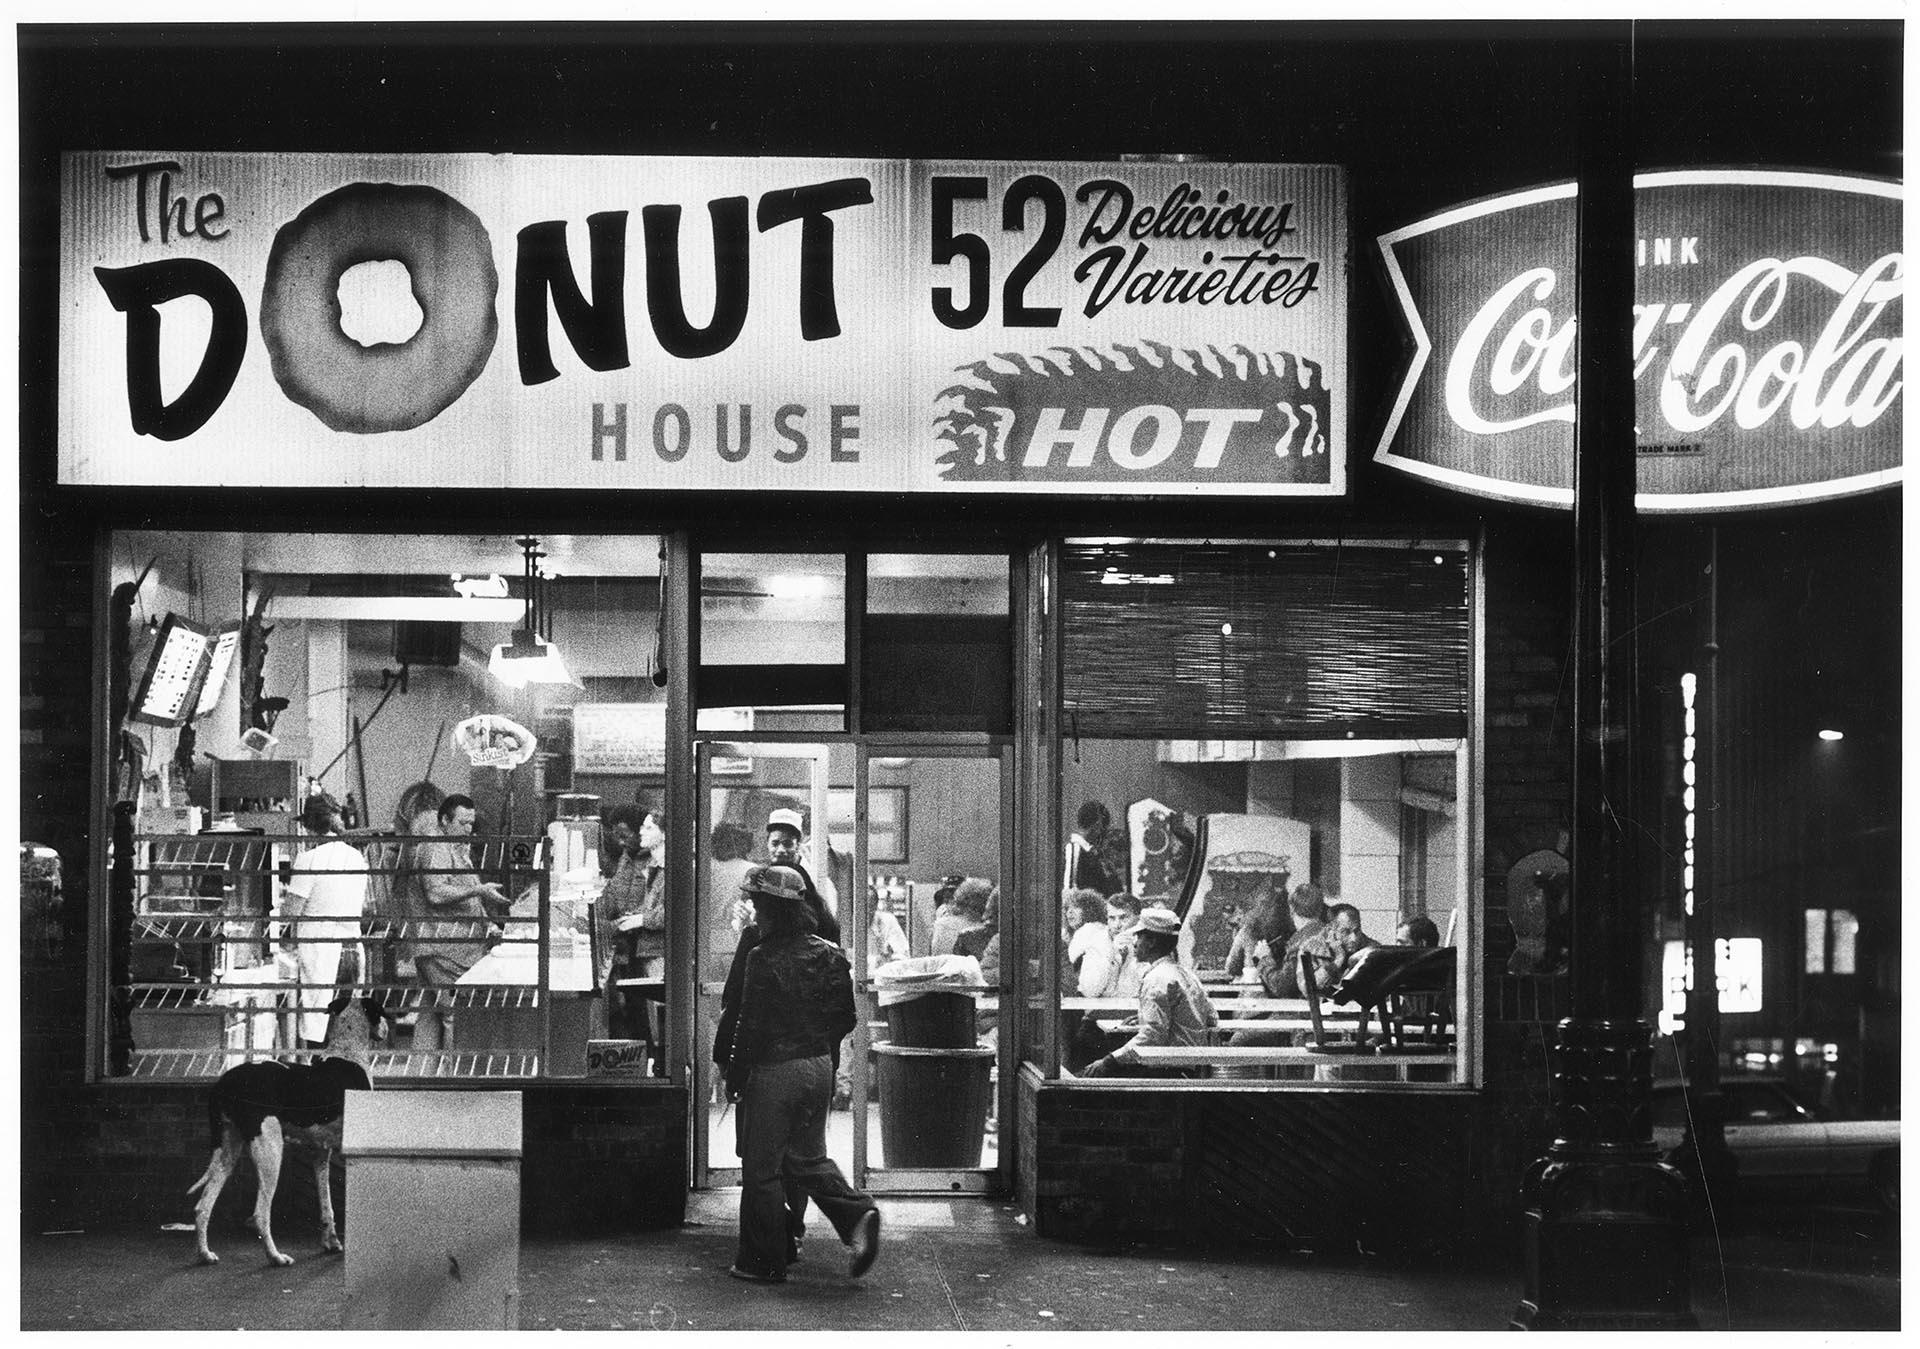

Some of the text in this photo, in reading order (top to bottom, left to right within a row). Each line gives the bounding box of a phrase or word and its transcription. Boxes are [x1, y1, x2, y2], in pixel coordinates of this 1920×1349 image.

[105, 160, 230, 244] The
[931, 174, 1296, 330] 52 Delicious
[1074, 242, 1320, 319] Varieties
[1637, 237, 1699, 267] INK
[94, 178, 875, 440] DONUT
[591, 402, 862, 463] HOUSE
[1022, 404, 1264, 470] HOT
[1637, 445, 1664, 453] TRADE
[1666, 444, 1691, 453] MARK
